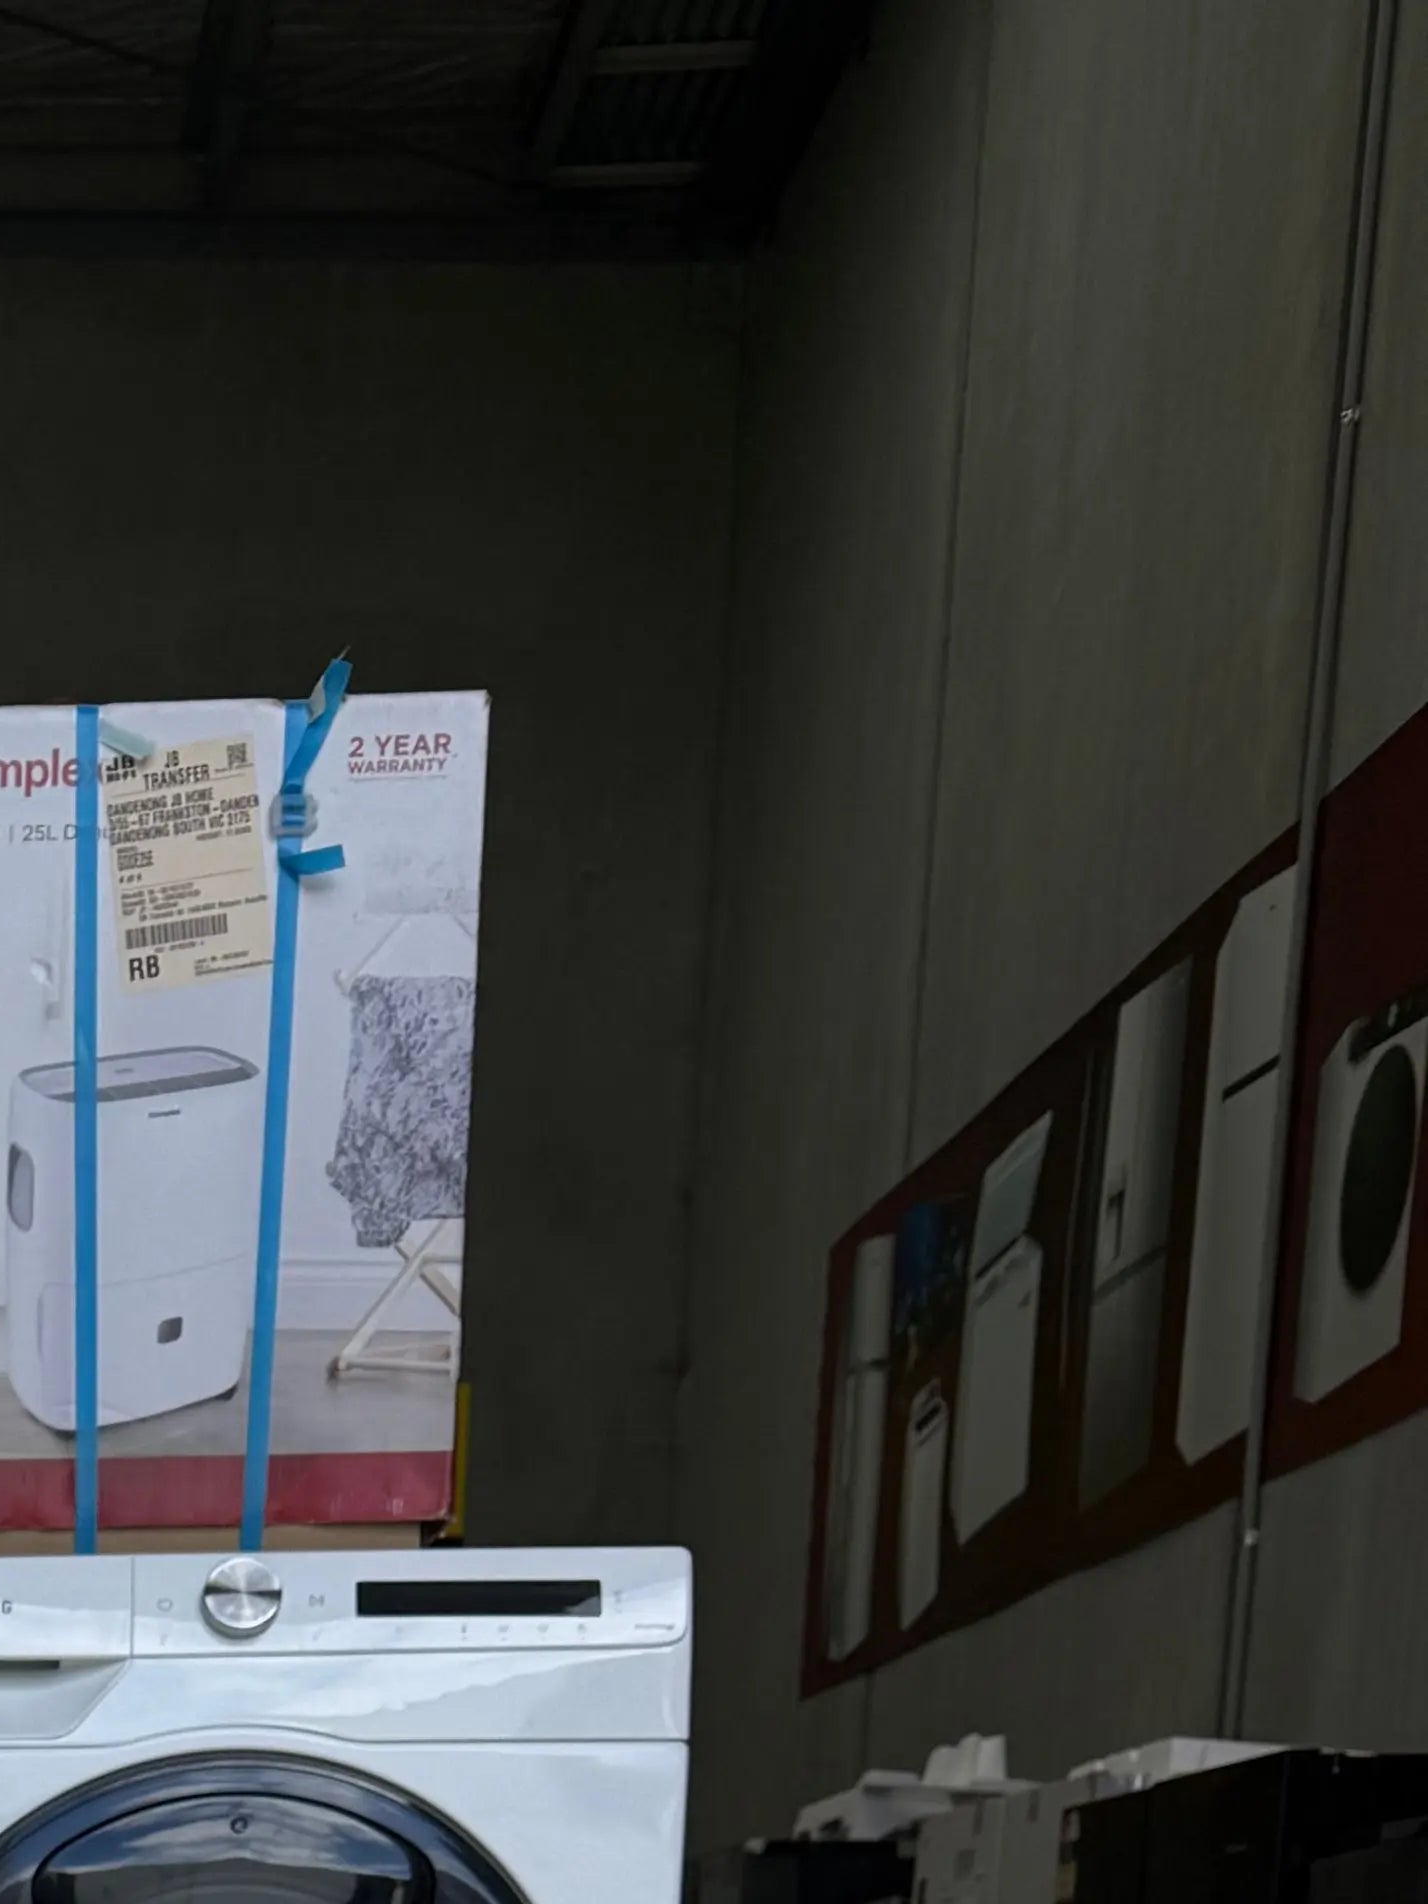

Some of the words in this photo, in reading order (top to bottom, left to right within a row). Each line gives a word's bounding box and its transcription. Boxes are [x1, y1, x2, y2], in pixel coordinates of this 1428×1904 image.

[349, 737, 364, 758] 2
[375, 733, 452, 756] YEAR
[164, 750, 179, 768] JB
[348, 758, 448, 774] WARRANTY
[143, 764, 210, 791] TRANSFER
[22, 824, 58, 843] 25L
[129, 954, 160, 982] RB
